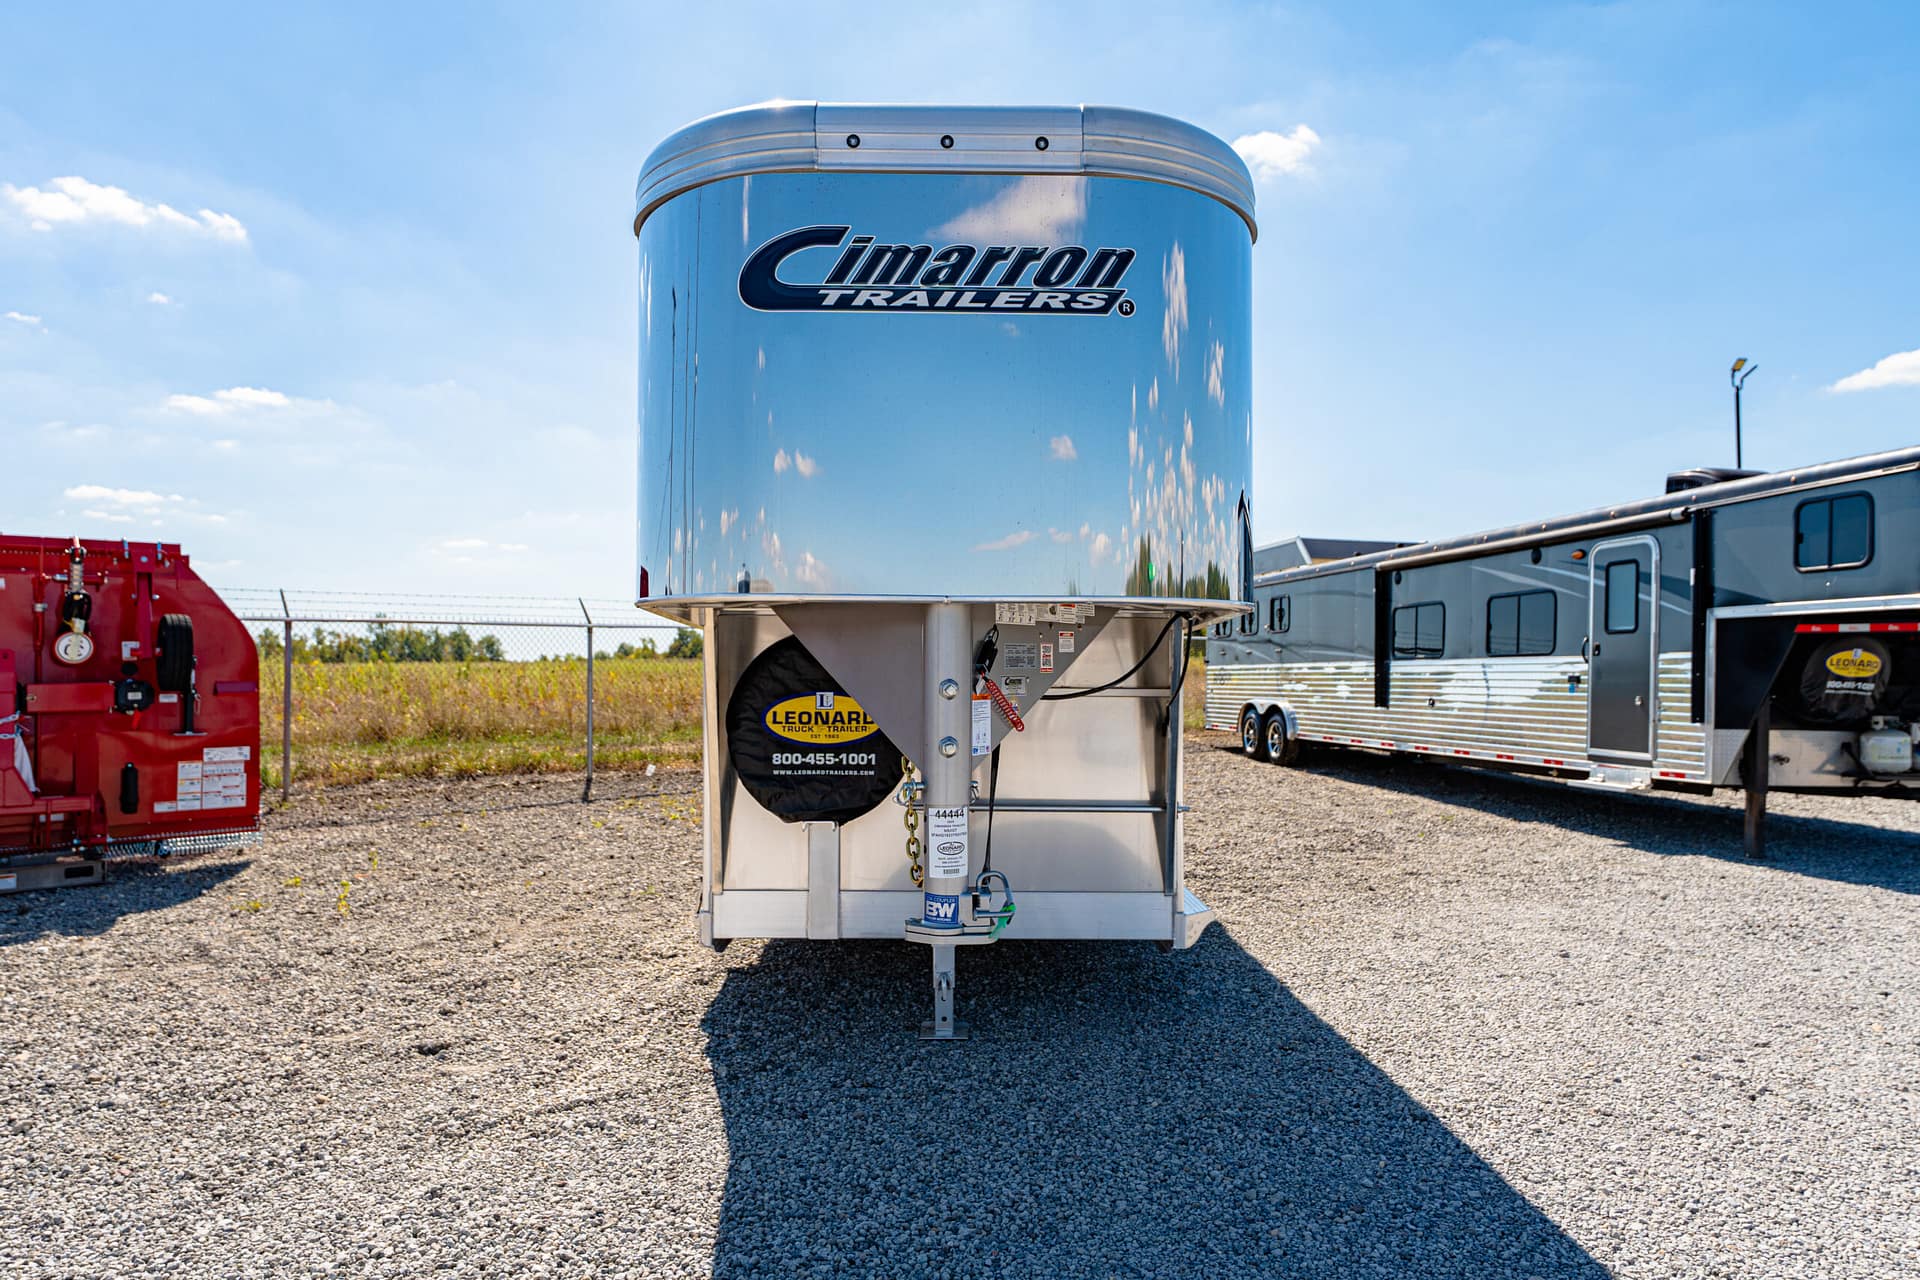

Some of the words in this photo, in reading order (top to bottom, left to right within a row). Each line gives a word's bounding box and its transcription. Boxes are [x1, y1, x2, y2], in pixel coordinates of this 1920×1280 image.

[738, 225, 1136, 312] Cimarron
[818, 289, 1109, 309] TRAILERS
[772, 753, 876, 765] 800-455-1001
[935, 809, 965, 819] 44444
